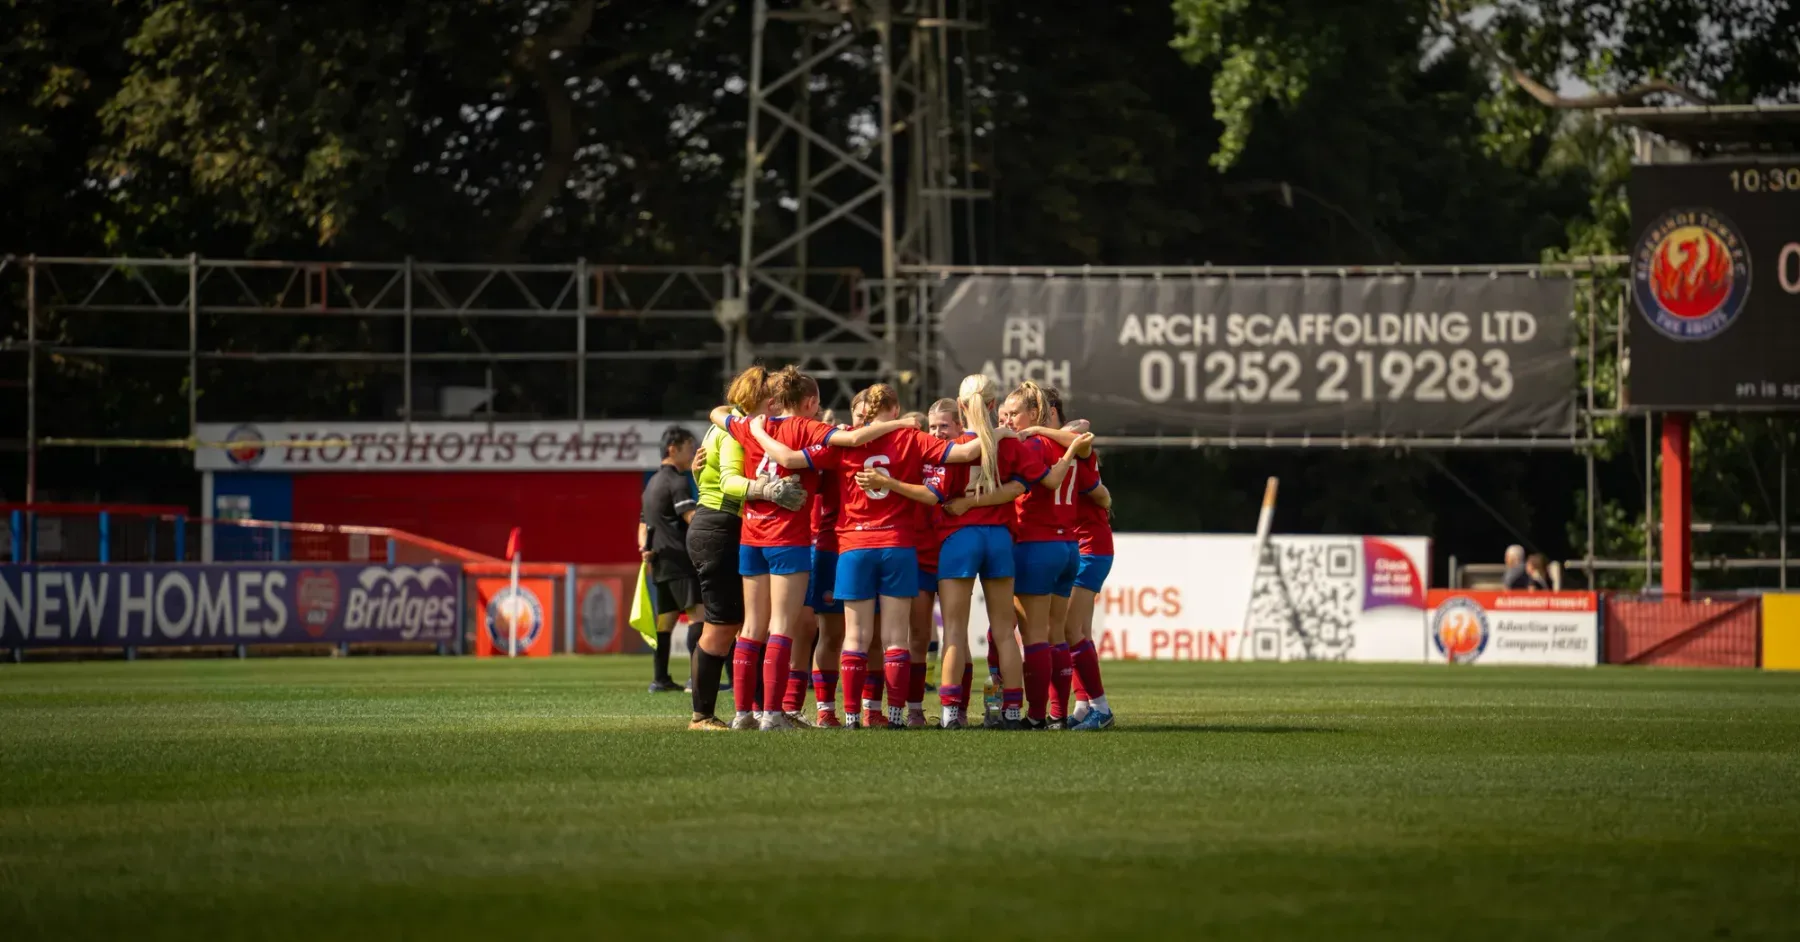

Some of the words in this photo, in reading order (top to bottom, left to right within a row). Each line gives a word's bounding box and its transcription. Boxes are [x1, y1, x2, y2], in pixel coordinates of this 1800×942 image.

[1730, 168, 1800, 192] 10:30
[1118, 313, 1217, 346] ARCH
[1225, 311, 1472, 346] SCAFFOLDING
[1481, 310, 1537, 344] LTD
[980, 359, 1071, 391] ARCH
[1140, 350, 1302, 403] 01252
[1316, 348, 1514, 402] 219283
[283, 431, 518, 464] HOTSHOTS
[528, 426, 645, 463] CAFÉ
[863, 454, 890, 500] 6
[0, 571, 108, 639] NEW
[117, 570, 288, 639] HOMES
[343, 583, 456, 640] Bridges
[1095, 586, 1183, 617] HICS
